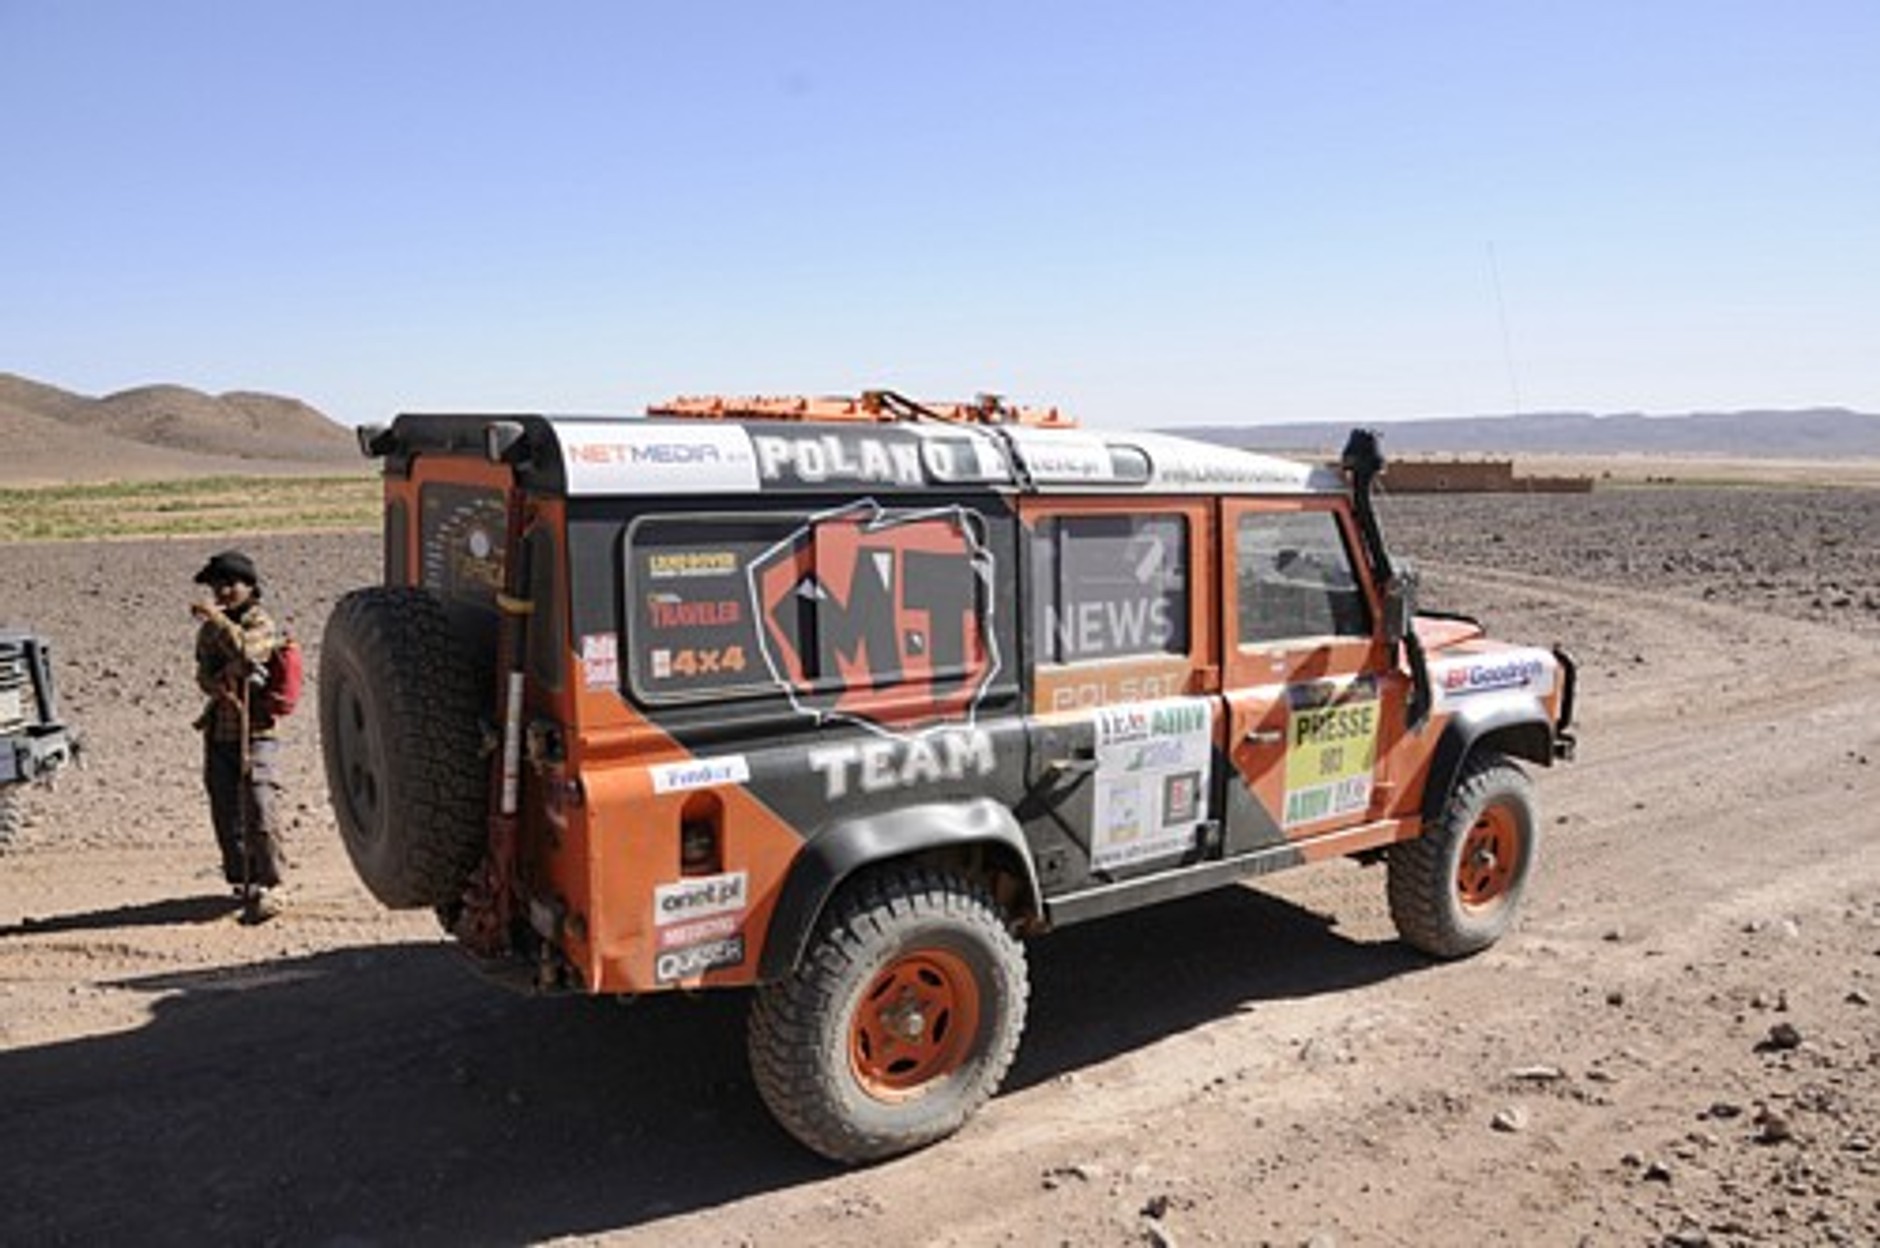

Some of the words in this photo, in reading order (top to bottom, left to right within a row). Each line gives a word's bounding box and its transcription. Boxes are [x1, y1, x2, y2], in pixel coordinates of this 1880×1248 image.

[569, 443, 720, 463] NETMEDIA
[1043, 599, 1173, 656] NEWS
[1296, 706, 1374, 746] PRESSE
[808, 730, 996, 800] TEAM
